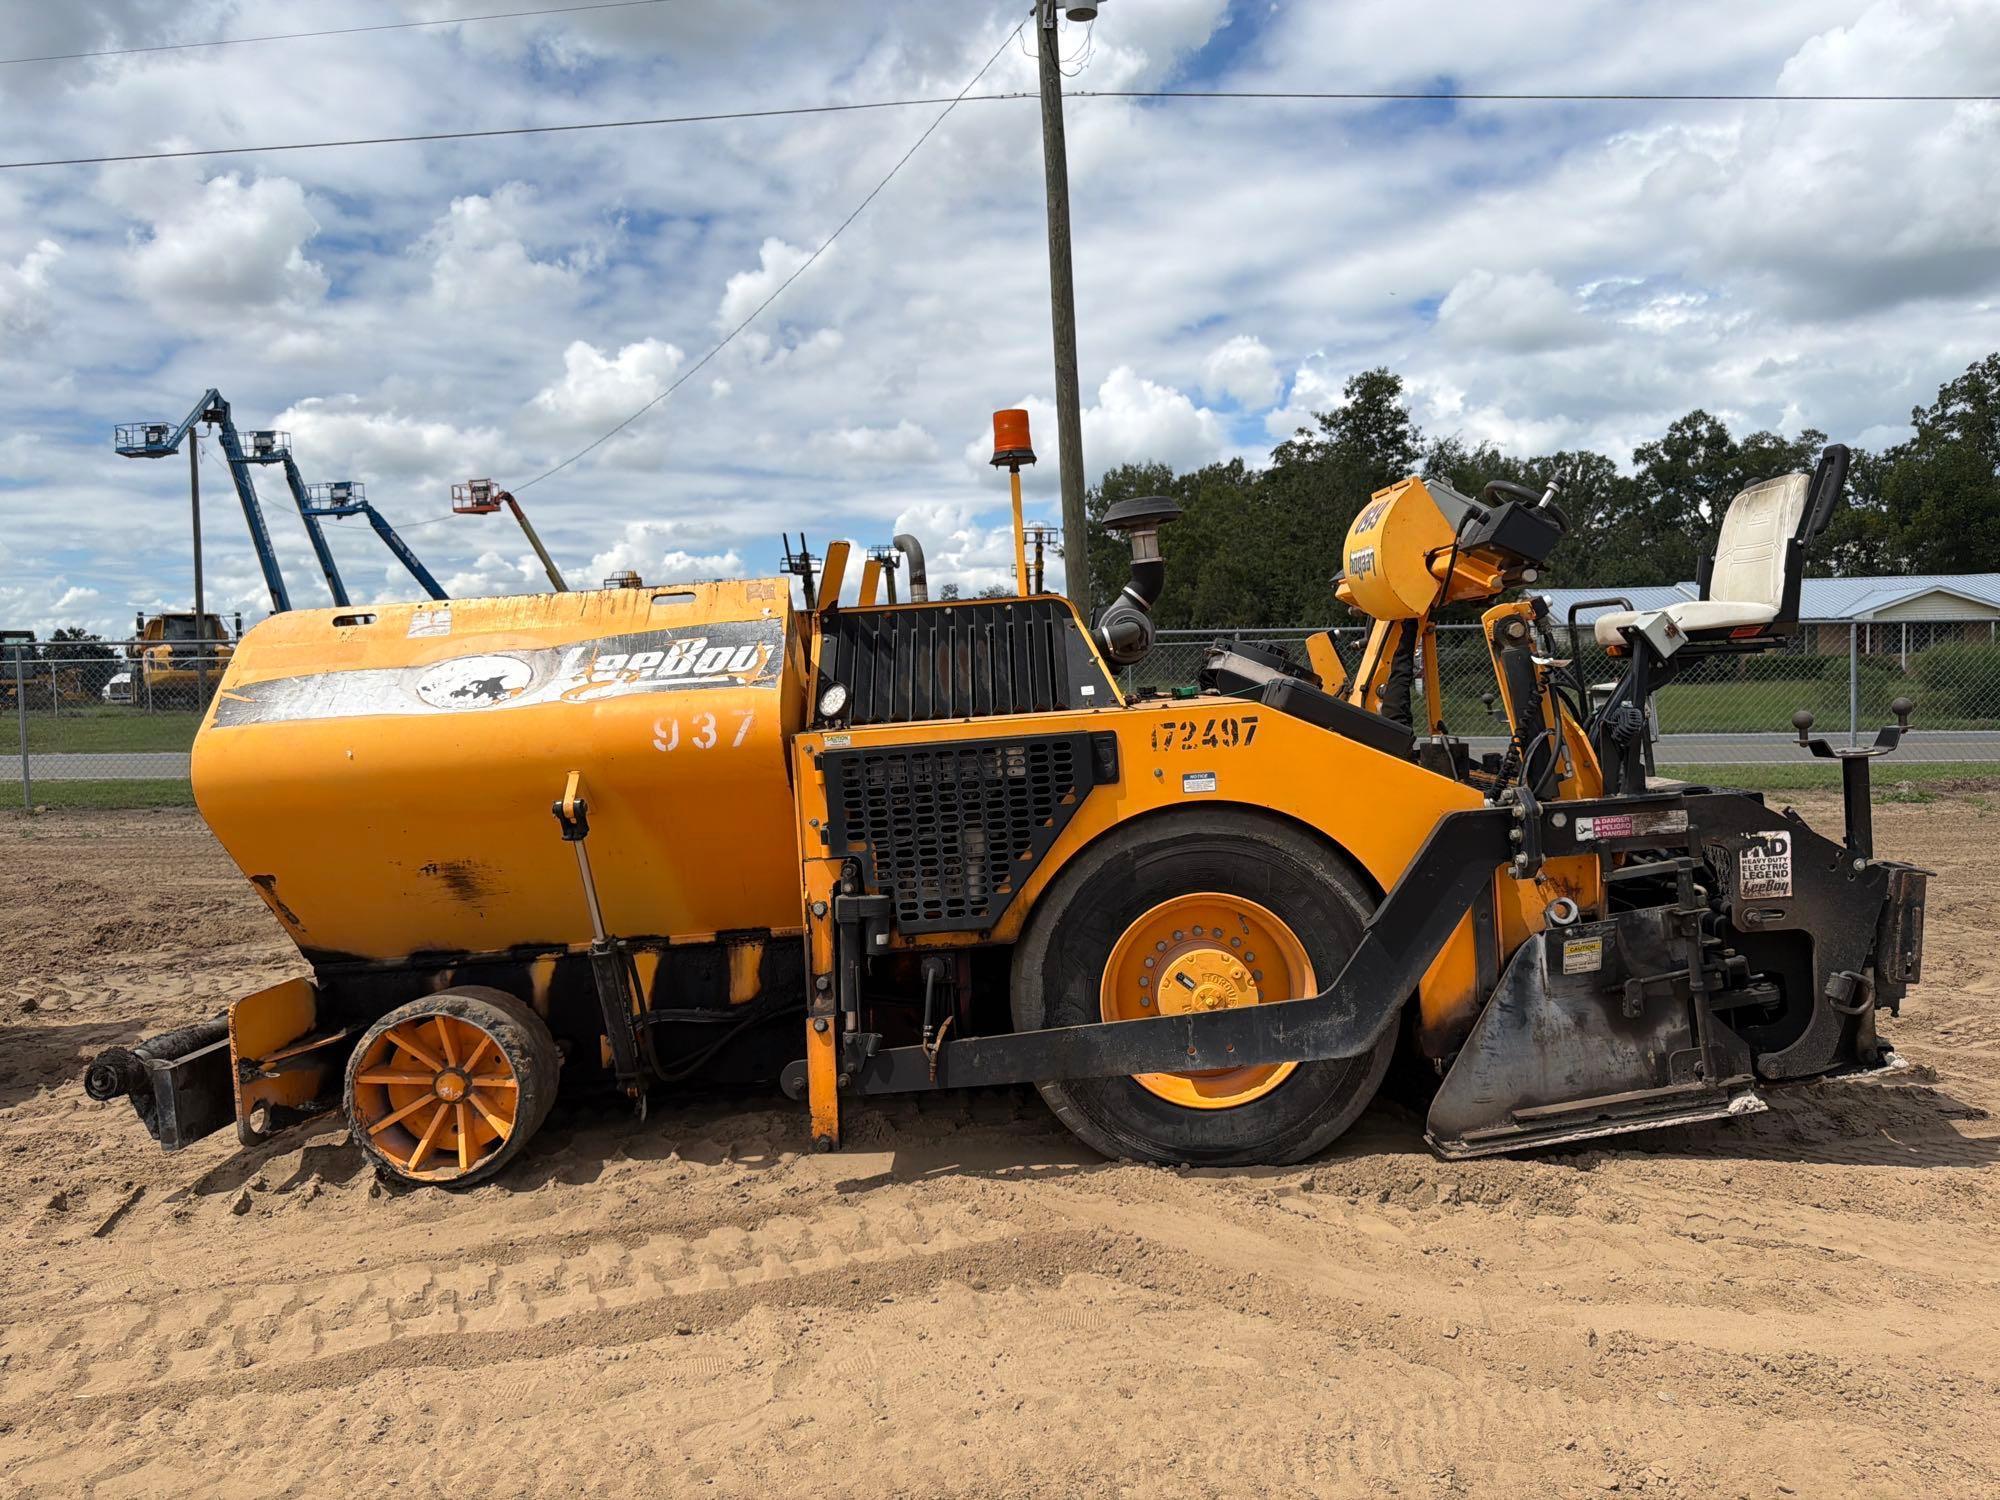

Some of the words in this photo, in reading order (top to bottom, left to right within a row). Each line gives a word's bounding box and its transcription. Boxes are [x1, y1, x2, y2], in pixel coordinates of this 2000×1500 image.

[558, 637, 775, 686] LeeBoy
[1601, 816, 1630, 824] DANGER
[1601, 823, 1631, 831] PELIGRO
[1742, 862, 1788, 872] ELECTRIC
[1743, 870, 1788, 880] LEGEND
[1743, 879, 1789, 894] LeeBoy
[1569, 944, 1596, 952] CAUTION
